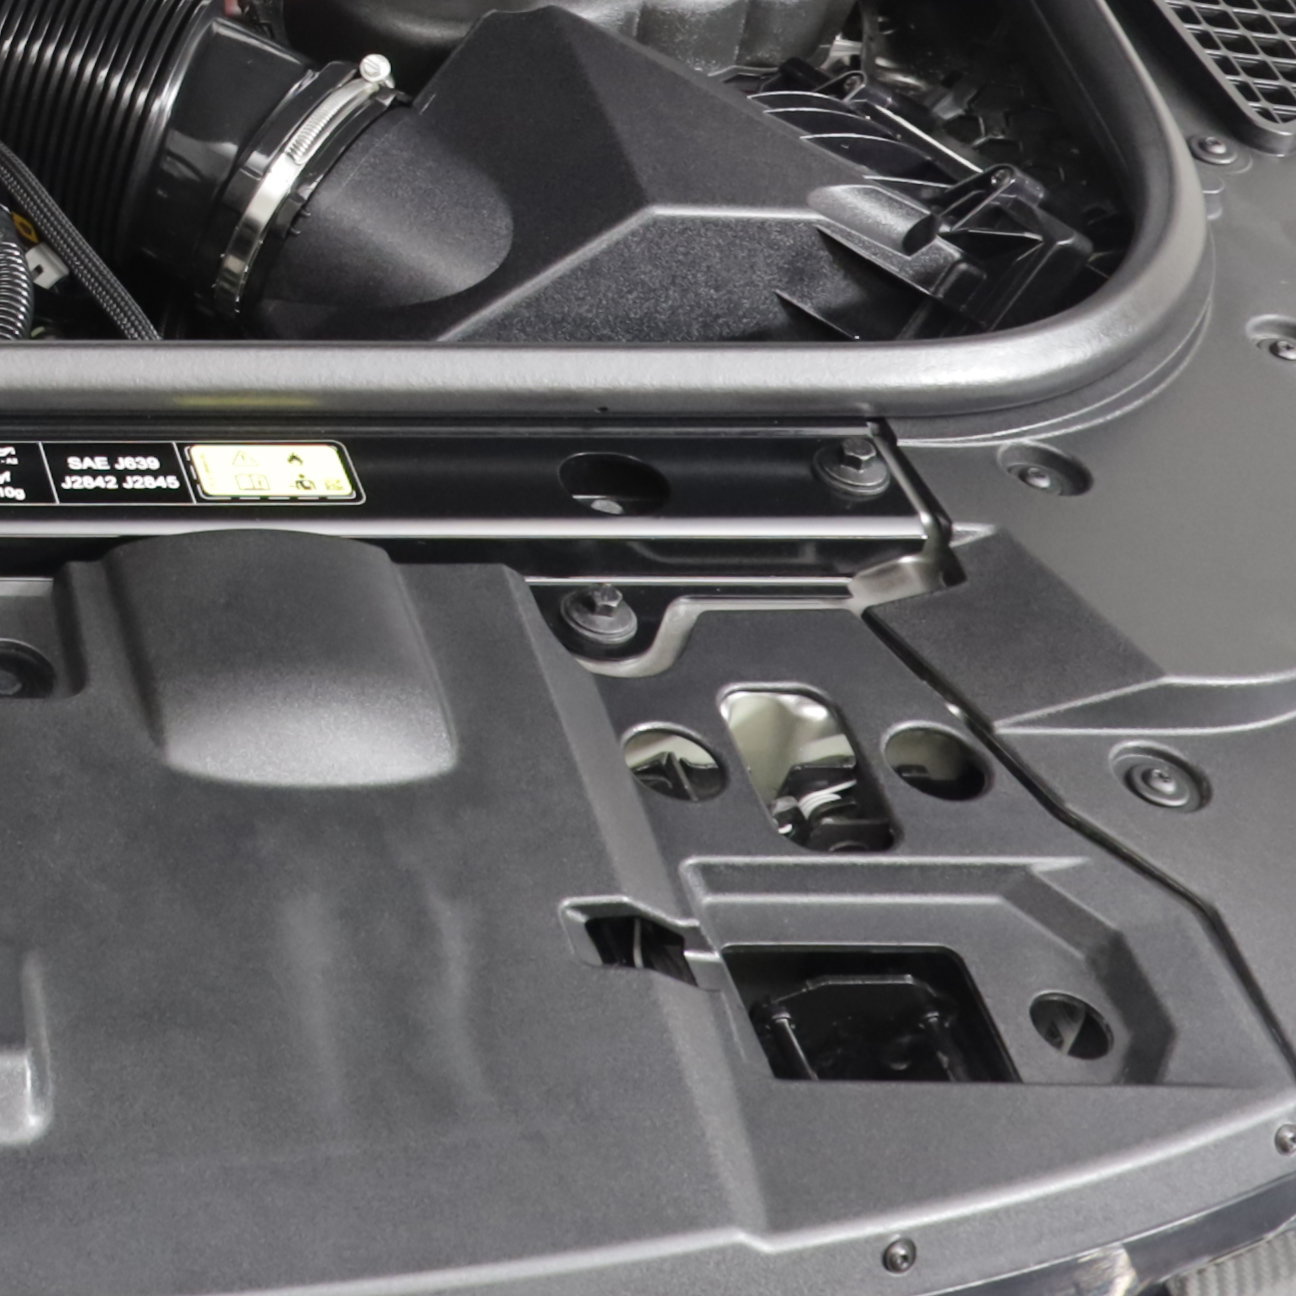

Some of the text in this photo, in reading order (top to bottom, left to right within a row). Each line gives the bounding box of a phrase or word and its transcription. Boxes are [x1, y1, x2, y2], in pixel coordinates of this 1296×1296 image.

[66, 456, 160, 470] SAE J639
[61, 475, 180, 489] J2842 J2845
